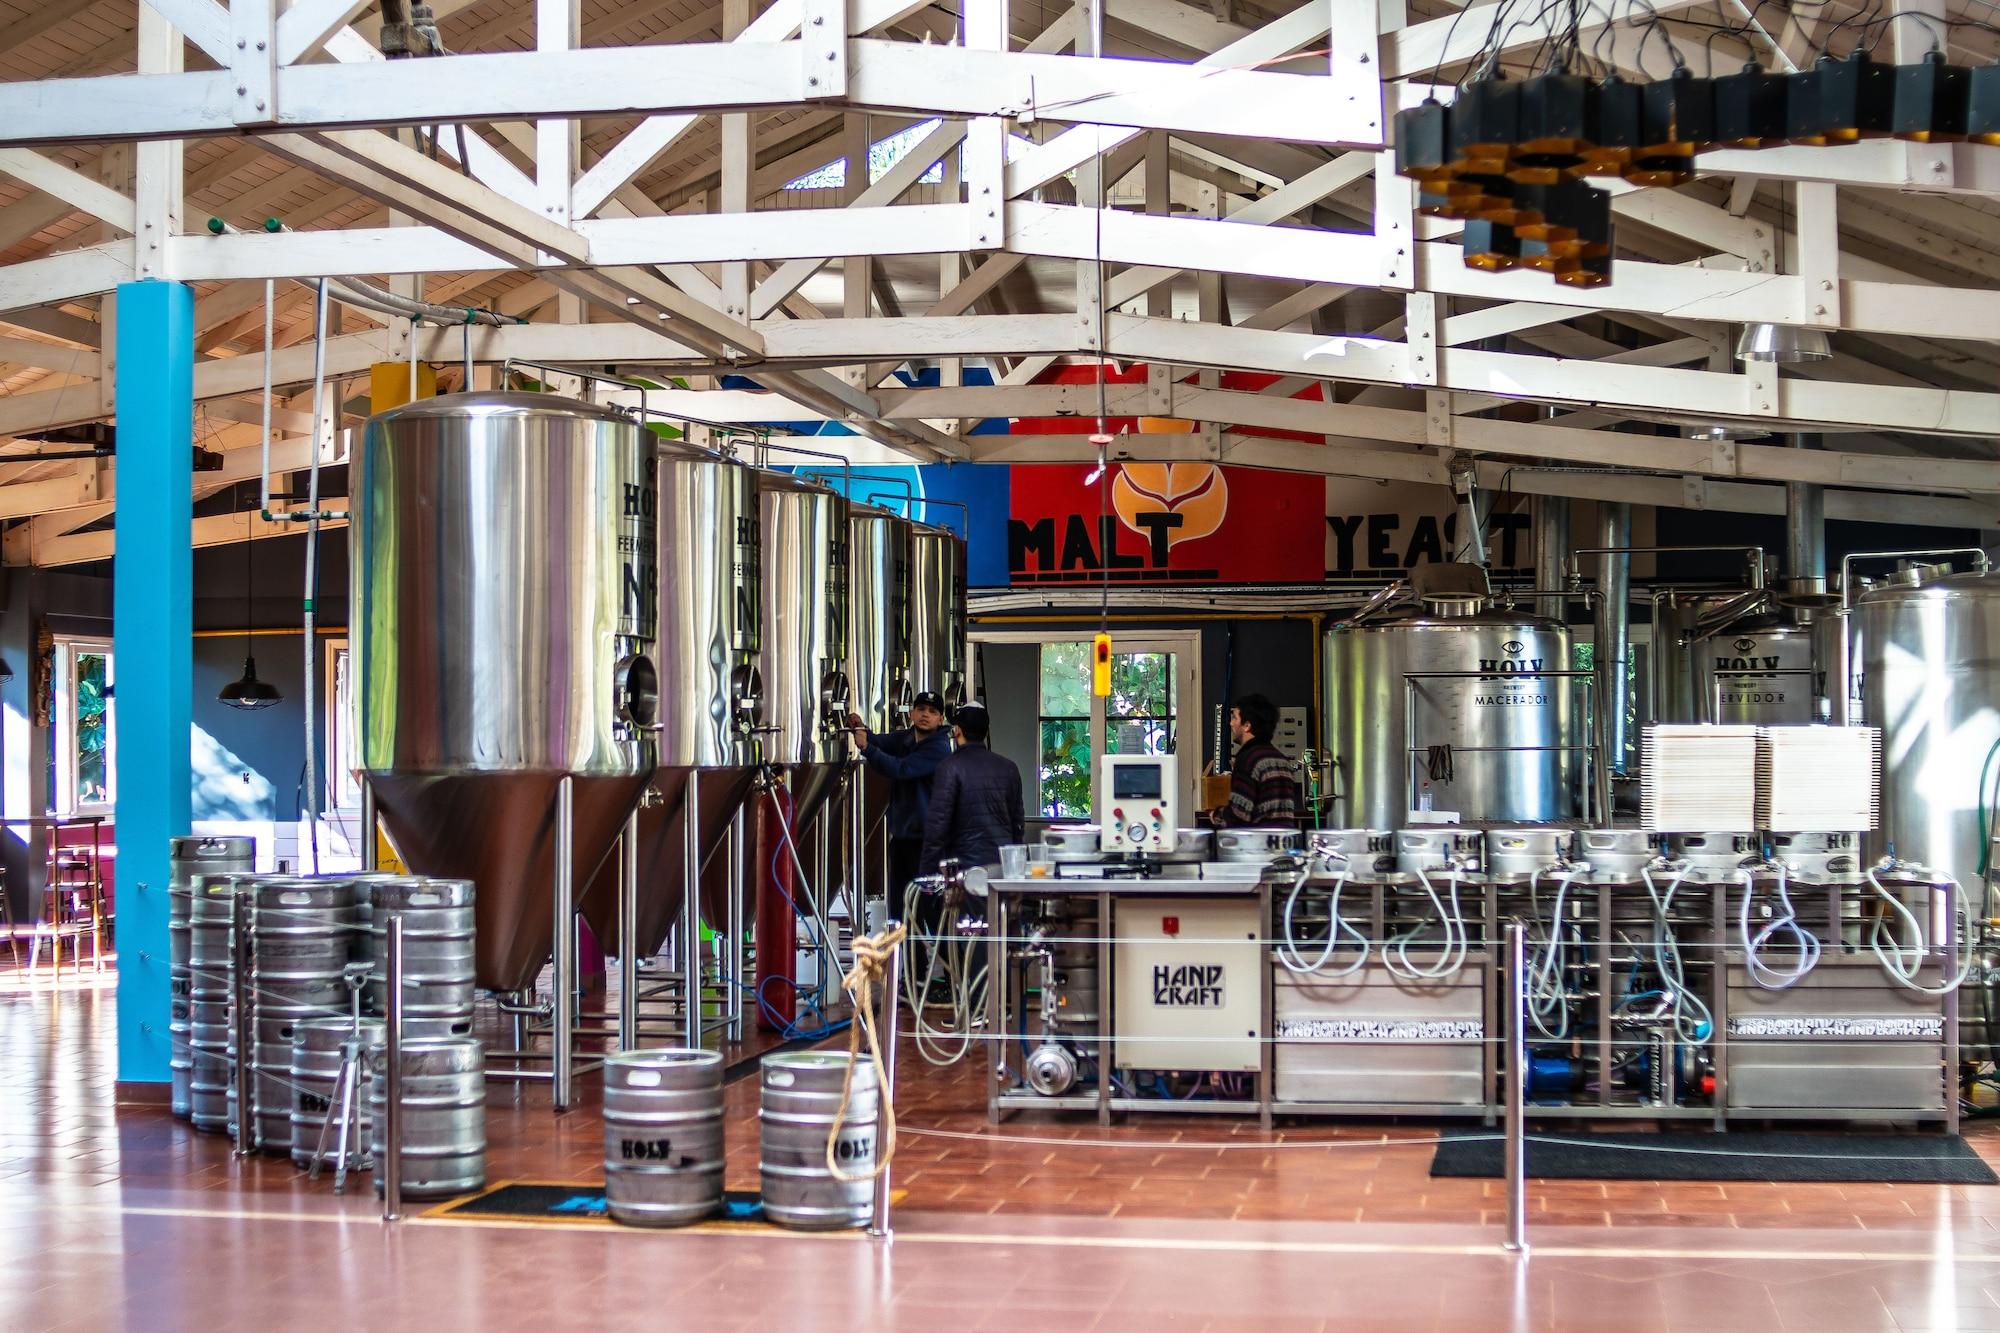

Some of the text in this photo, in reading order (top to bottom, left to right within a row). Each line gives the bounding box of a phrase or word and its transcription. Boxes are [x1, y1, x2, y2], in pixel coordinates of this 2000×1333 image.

[1008, 512, 1184, 571] MALT
[1479, 658, 1544, 681] HOLY
[1716, 656, 1780, 679] HOLY
[1474, 695, 1549, 705] MACERADOR
[1720, 693, 1785, 703] ERVIDOR
[1154, 965, 1223, 989] HAND
[1154, 987, 1223, 1005] CRAFT
[621, 1139, 671, 1160] HOLY
